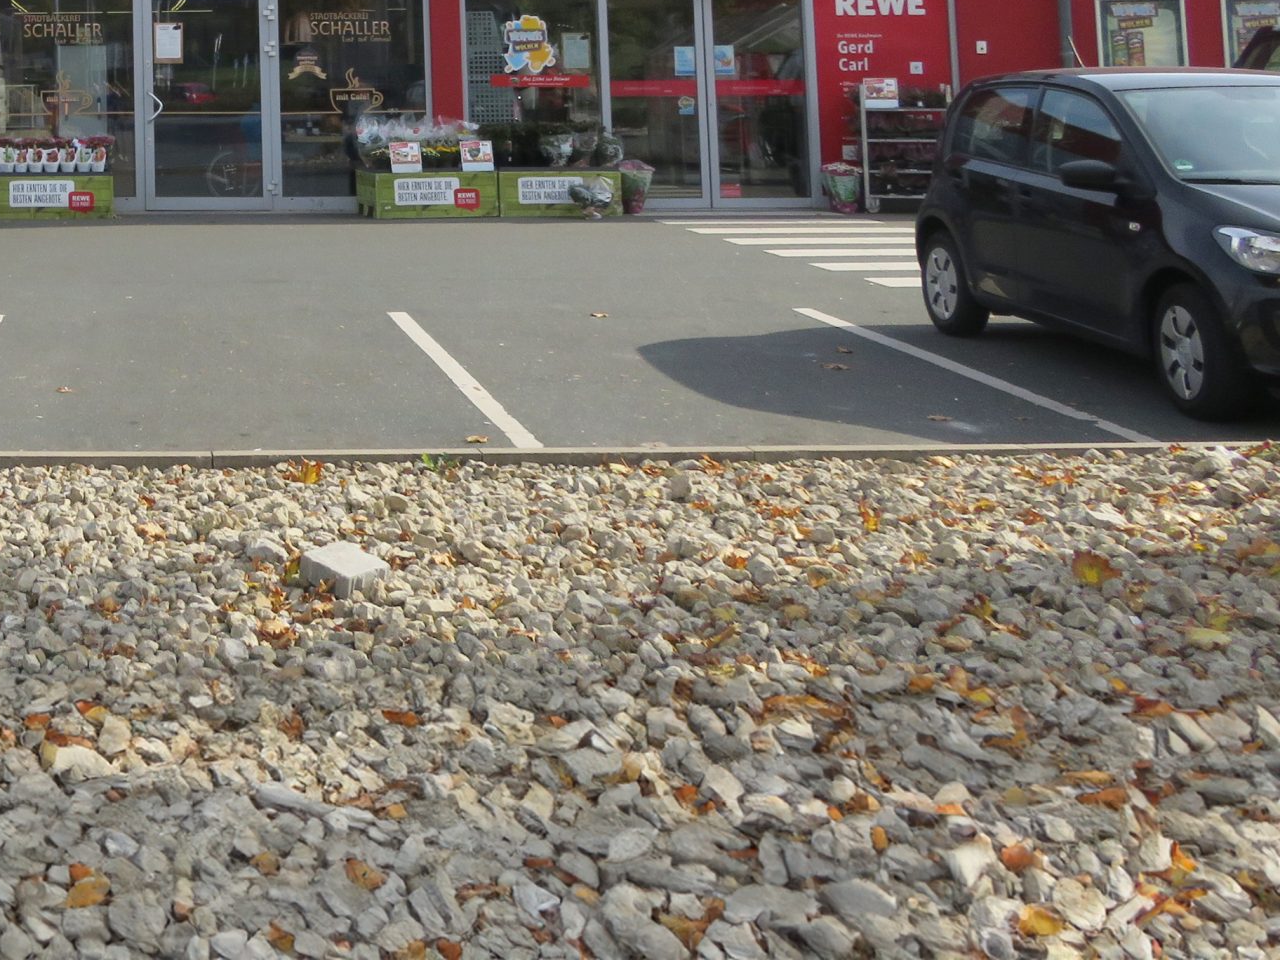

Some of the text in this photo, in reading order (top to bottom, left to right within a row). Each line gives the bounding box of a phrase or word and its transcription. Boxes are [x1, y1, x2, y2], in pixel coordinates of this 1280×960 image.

[23, 15, 81, 23] STADTBÄCKEREI
[310, 12, 368, 20] STADTBÄCKEREI
[23, 23, 102, 37] SCHALLER
[310, 21, 390, 35] SCHALLER
[838, 40, 874, 54] Gerd
[839, 57, 869, 71] Carl
[13, 184, 24, 193] HIER
[26, 184, 47, 193] ERNTEN
[49, 184, 58, 193] SIE
[398, 181, 452, 190] HIER ERNTEN SIE DIE
[522, 180, 534, 189] HIER
[535, 180, 555, 189] ERNTEN
[557, 180, 566, 189] SIE
[13, 194, 32, 203] BESTEN
[398, 192, 417, 201] BESTEN
[522, 191, 571, 200] BESTEN ANGEBOT
